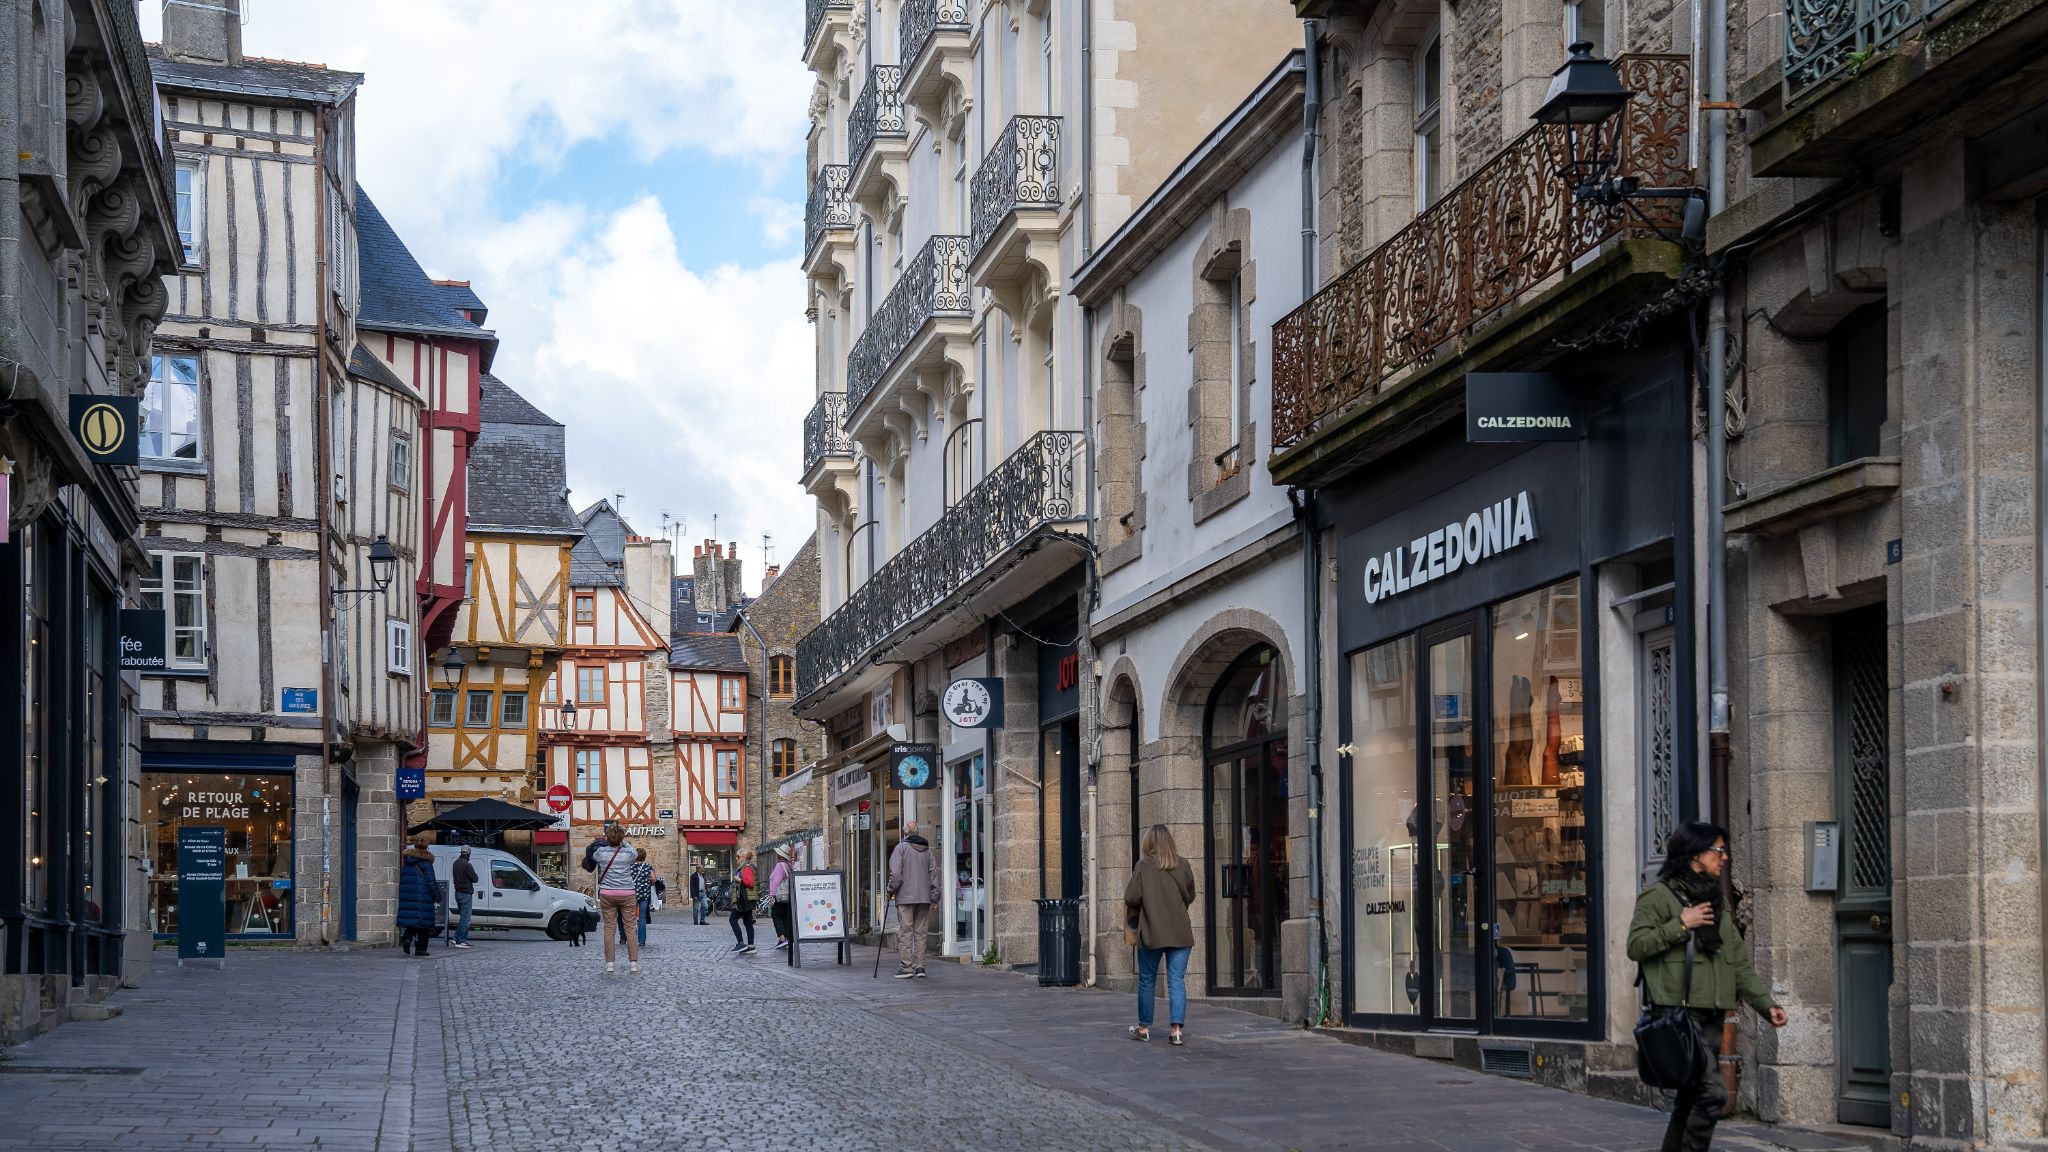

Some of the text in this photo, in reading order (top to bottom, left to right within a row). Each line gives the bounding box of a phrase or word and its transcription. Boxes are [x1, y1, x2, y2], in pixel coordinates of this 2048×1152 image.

[1477, 416, 1572, 428] CALZEDONIA
[1364, 490, 1536, 604] CALZEDONIA
[120, 636, 142, 657] fée
[121, 656, 164, 666] raboutée
[1056, 654, 1077, 689] JOT
[971, 681, 983, 692] The
[188, 792, 243, 803] RETOUR
[182, 806, 249, 819] DE PLAGE
[624, 826, 665, 836] ALITHES
[445, 832, 496, 845] dessos
[1353, 847, 1379, 861] SCULPTE
[1353, 861, 1379, 876] SUBLIME
[1353, 874, 1385, 890] SOUTIENT
[1366, 900, 1406, 915] CALZEDONIA
